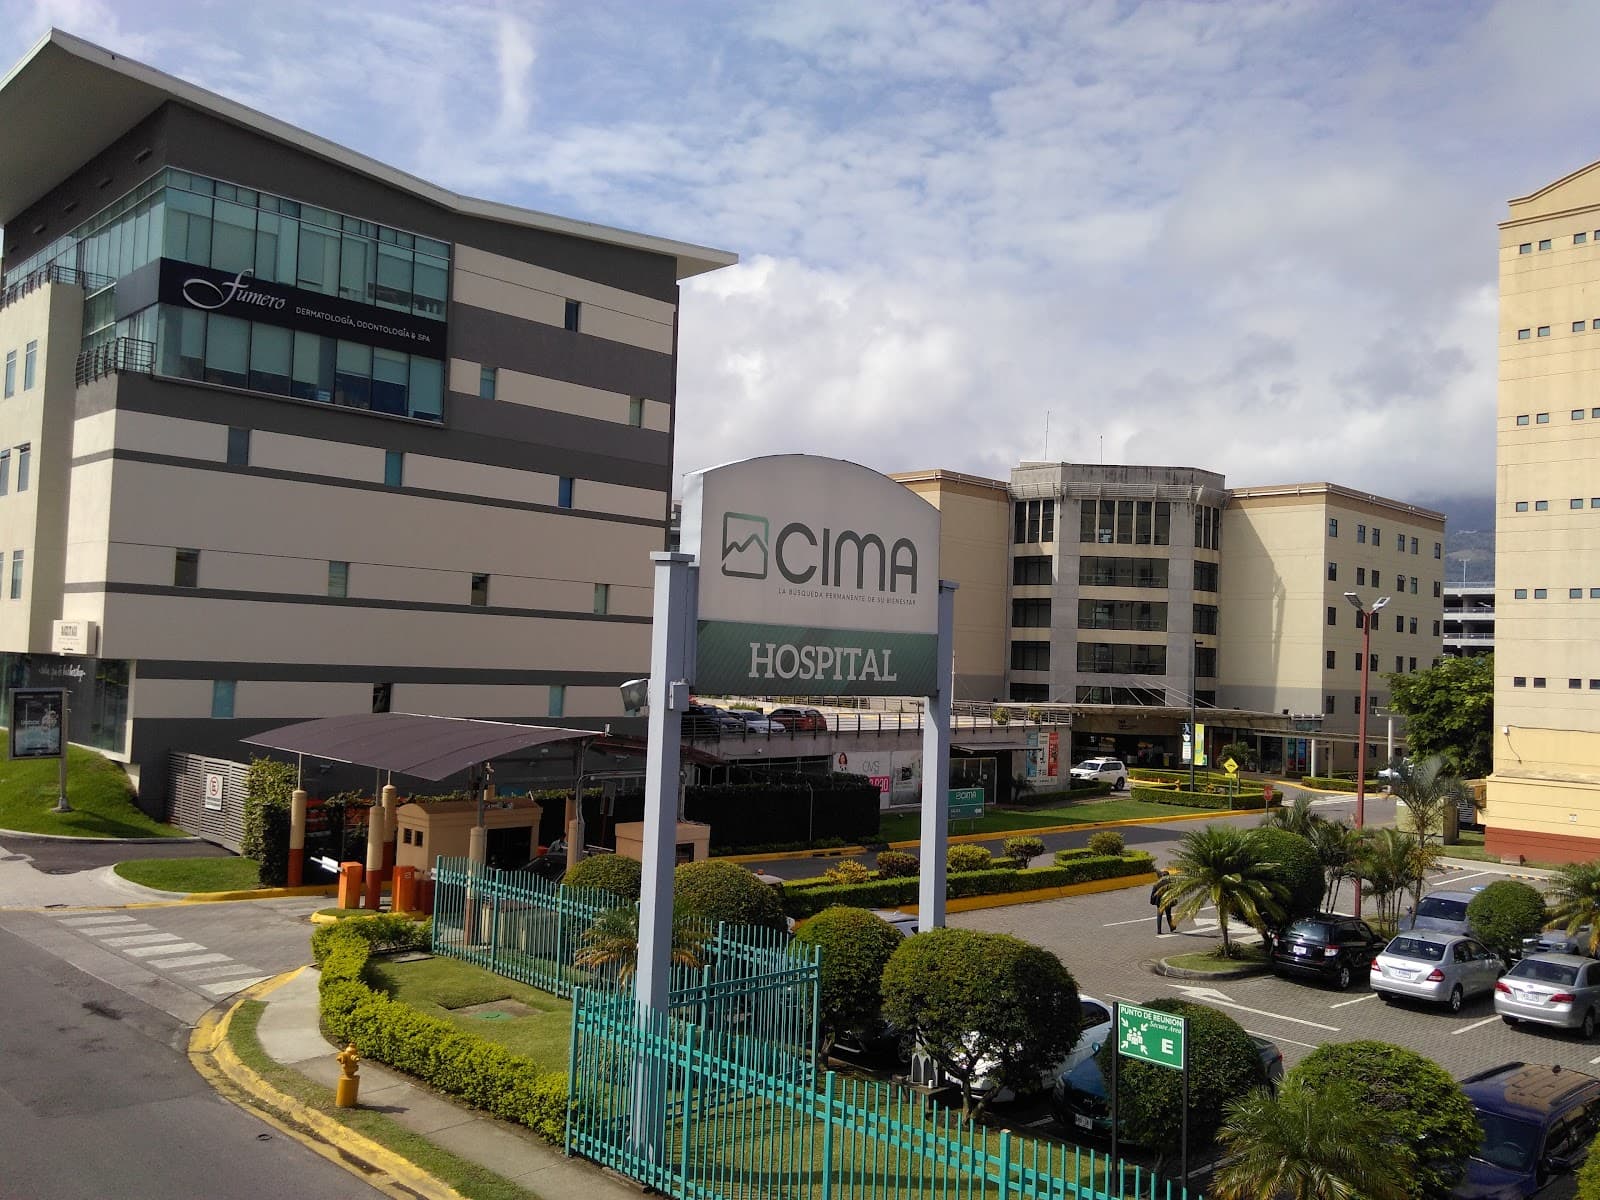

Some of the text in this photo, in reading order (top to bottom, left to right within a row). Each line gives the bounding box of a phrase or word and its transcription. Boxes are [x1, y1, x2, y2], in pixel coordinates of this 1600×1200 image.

[295, 306, 356, 328] DERMATOLOGÍA,
[356, 320, 410, 339] ODONTOLOGÍA
[417, 333, 431, 343] SPA
[775, 522, 918, 594] CIMA
[825, 592, 865, 602] PERMANENTE
[748, 642, 897, 682] HOSPITAL
[1120, 1006, 1143, 1018] PUNTO
[1143, 1011, 1152, 1020] DE
[1161, 1037, 1174, 1055] E
